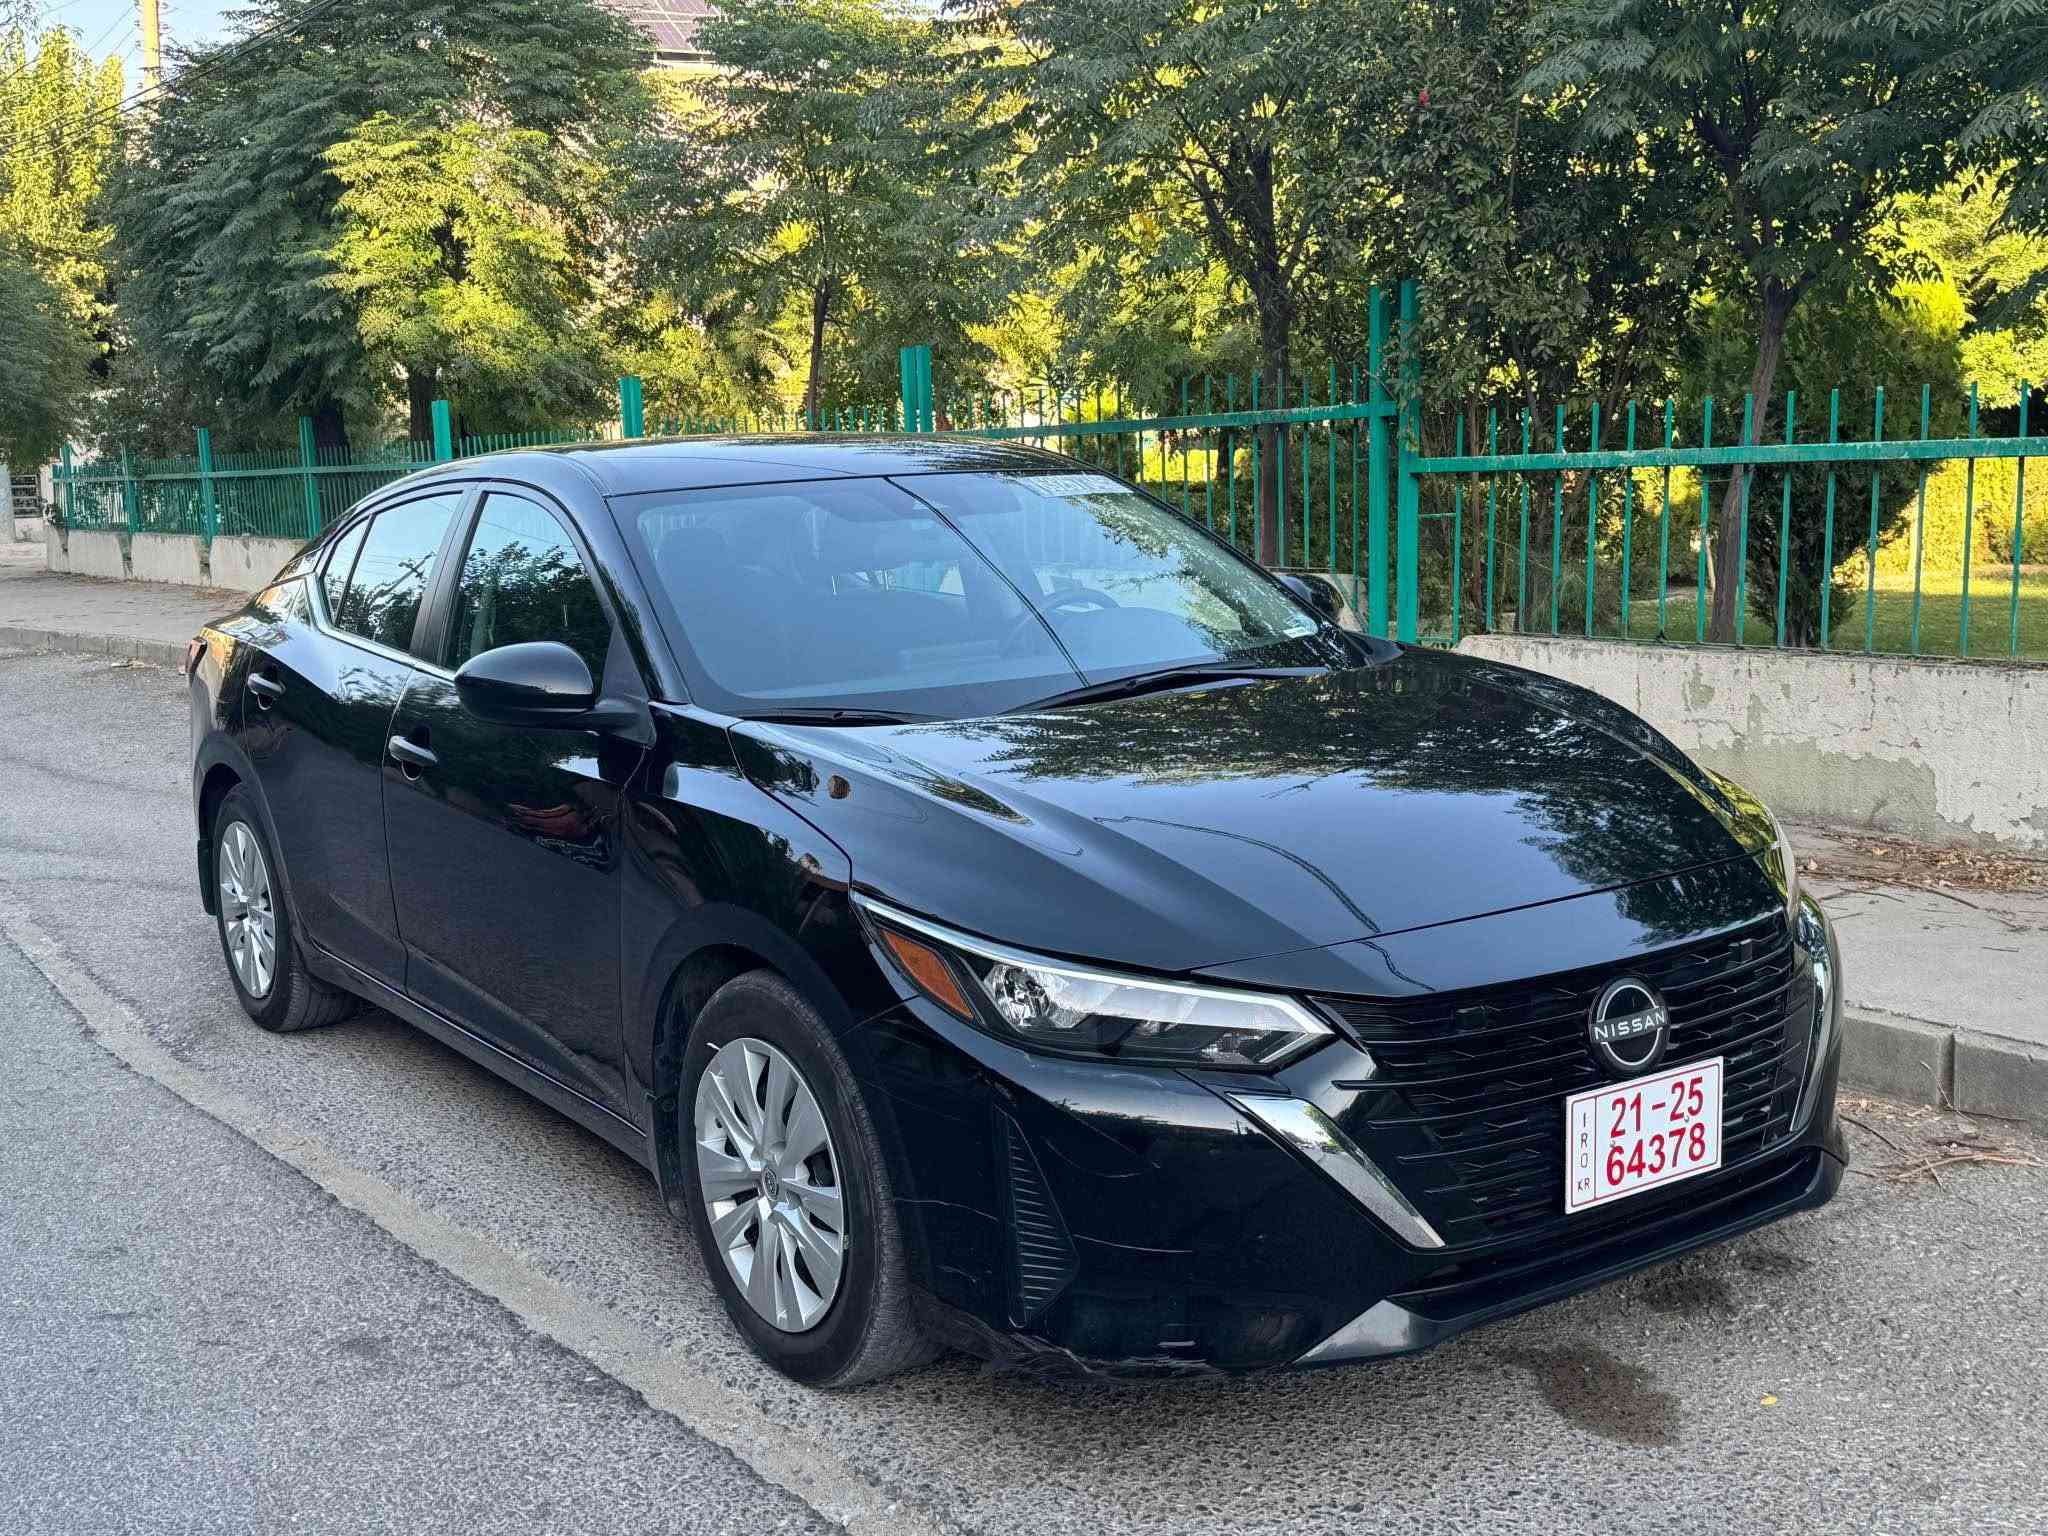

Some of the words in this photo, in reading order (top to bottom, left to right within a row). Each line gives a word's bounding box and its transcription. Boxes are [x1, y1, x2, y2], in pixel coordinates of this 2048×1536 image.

[1594, 1010, 1665, 1040] NISSAN
[1606, 1122, 1706, 1186] 64378
[1577, 1178, 1590, 1192] KR
